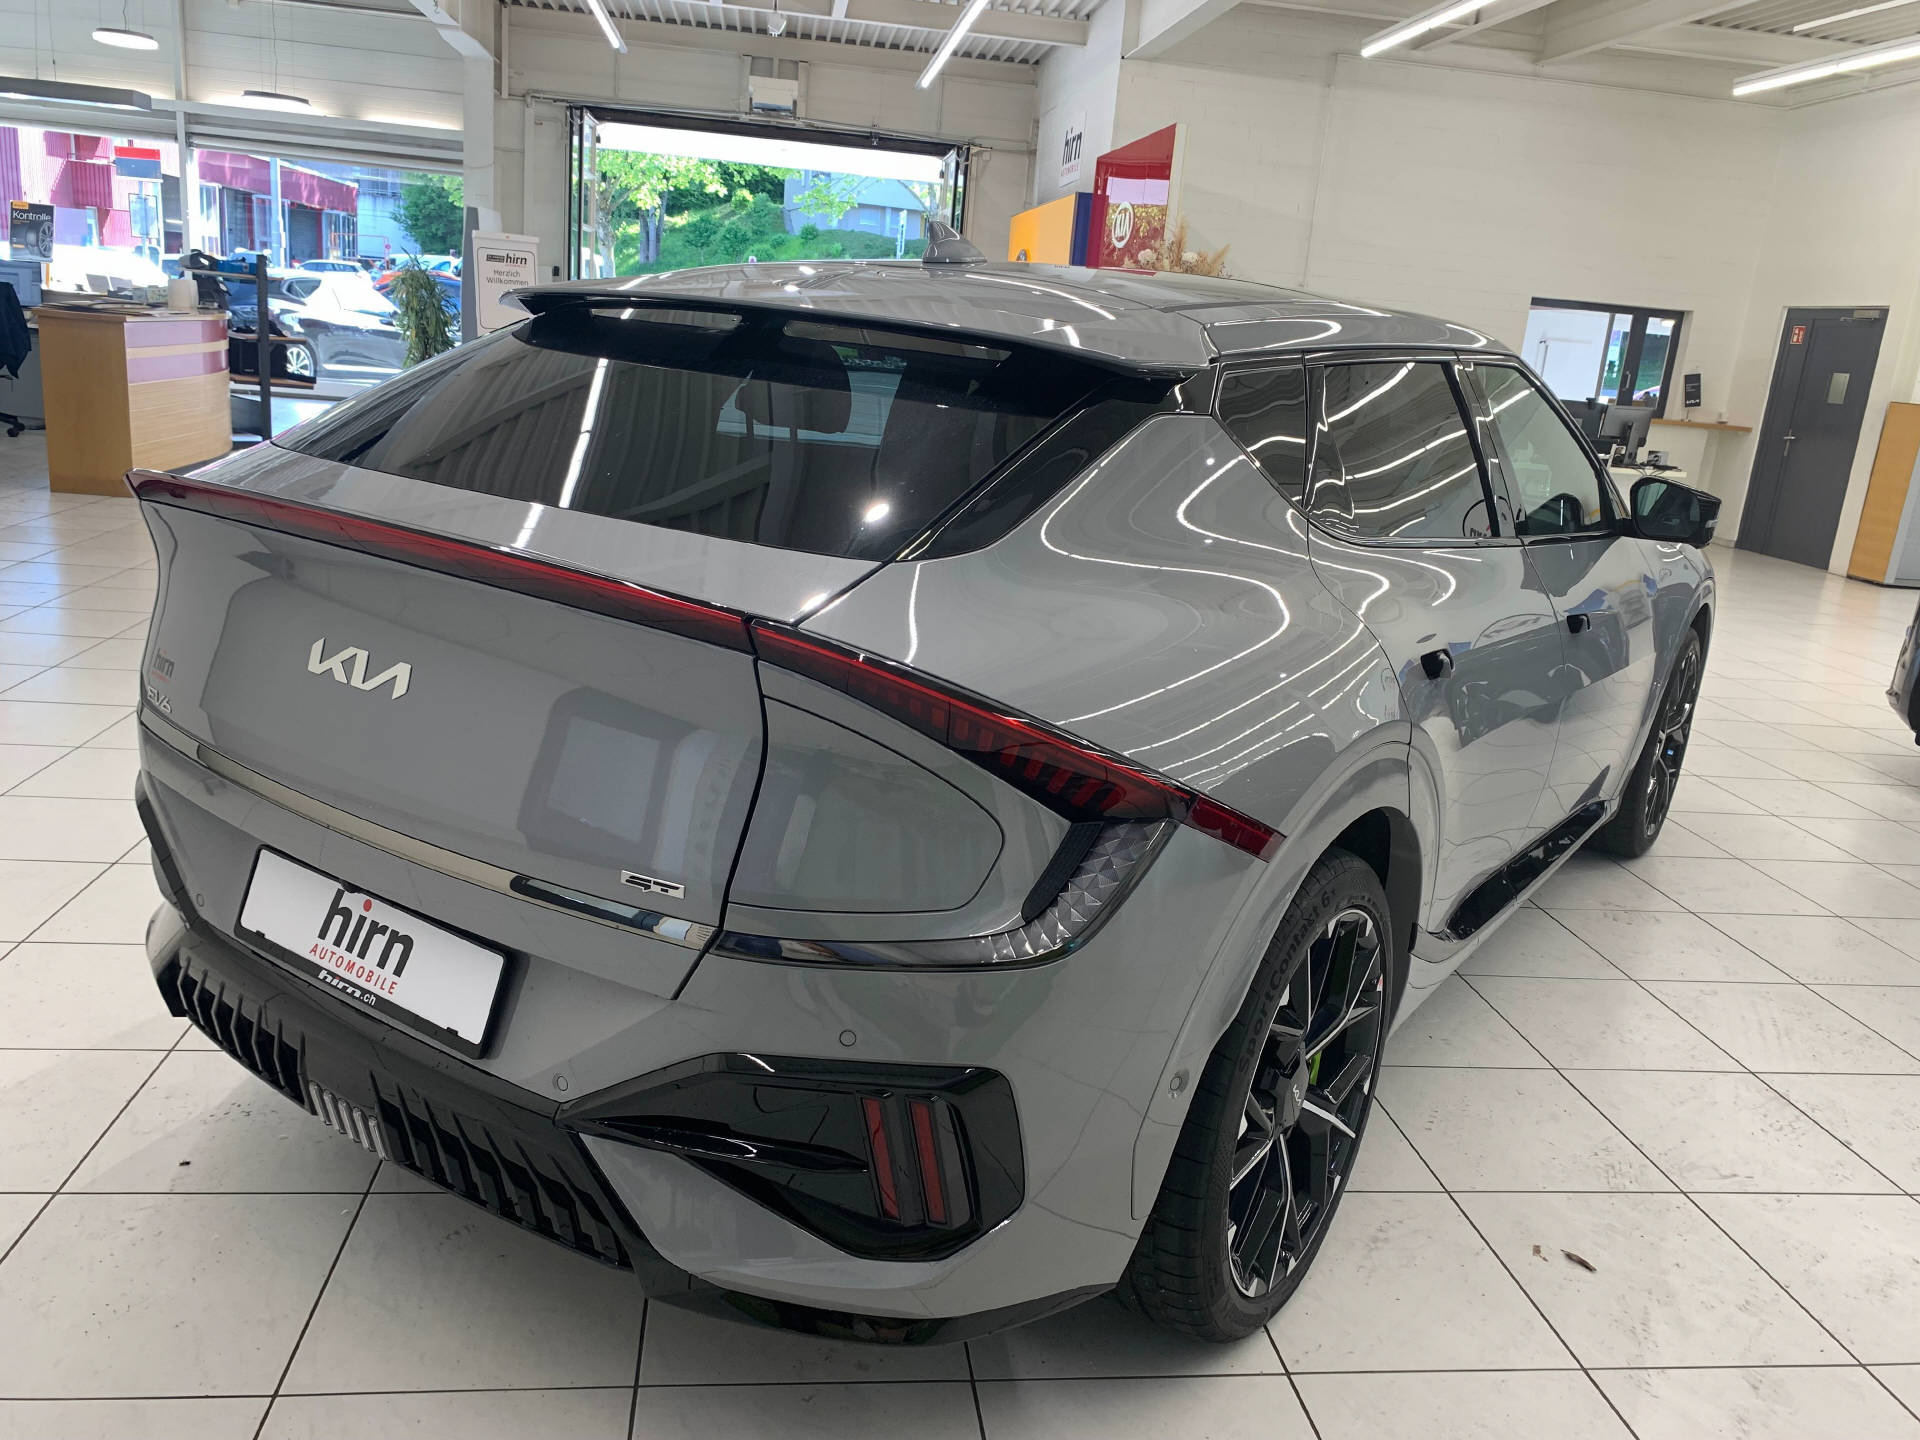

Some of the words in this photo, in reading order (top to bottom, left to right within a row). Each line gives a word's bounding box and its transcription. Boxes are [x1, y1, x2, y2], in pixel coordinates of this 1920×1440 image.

[1062, 126, 1082, 167] hirn
[12, 210, 52, 221] Kontrolle
[493, 269, 520, 277] Herzlich
[505, 252, 527, 264] hirn
[486, 277, 528, 286] Willkommen
[307, 637, 412, 700] KIA
[147, 686, 172, 713] EV6
[317, 888, 414, 978] hirn
[309, 943, 398, 995] AUTOMOBILE
[317, 969, 377, 1006] hirn.ch
